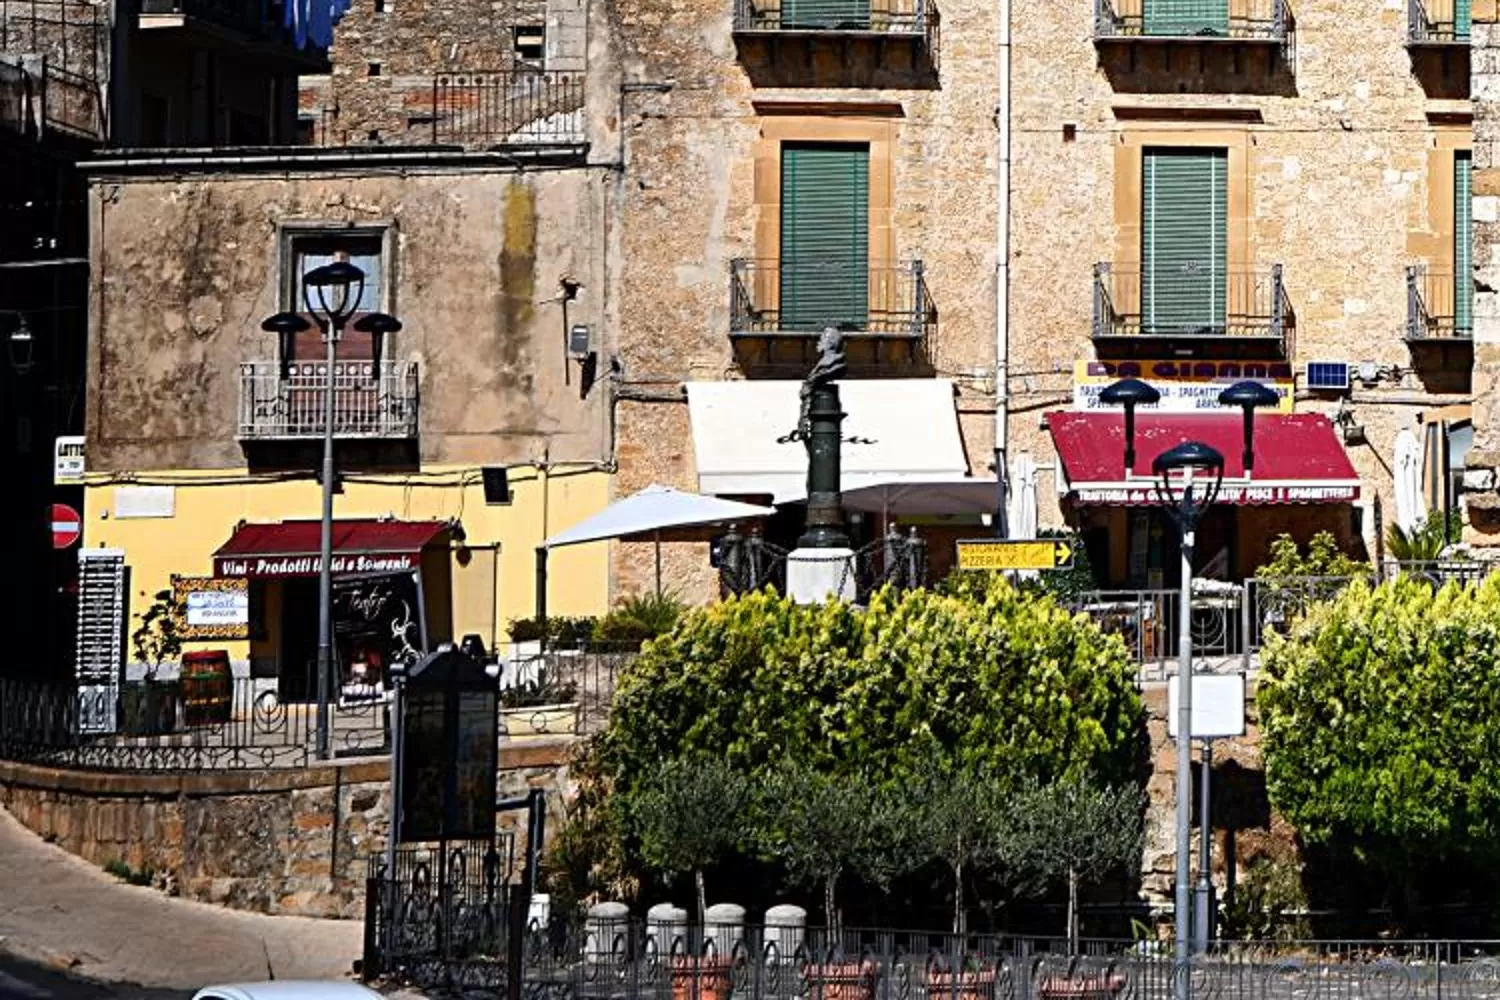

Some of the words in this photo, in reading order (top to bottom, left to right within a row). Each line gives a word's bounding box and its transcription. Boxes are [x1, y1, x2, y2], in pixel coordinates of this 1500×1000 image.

[1078, 489, 1128, 501] TRATTORIA
[222, 560, 247, 575] Vini
[256, 558, 311, 575] Prodotti
[961, 555, 1003, 567] PIZZERIA
